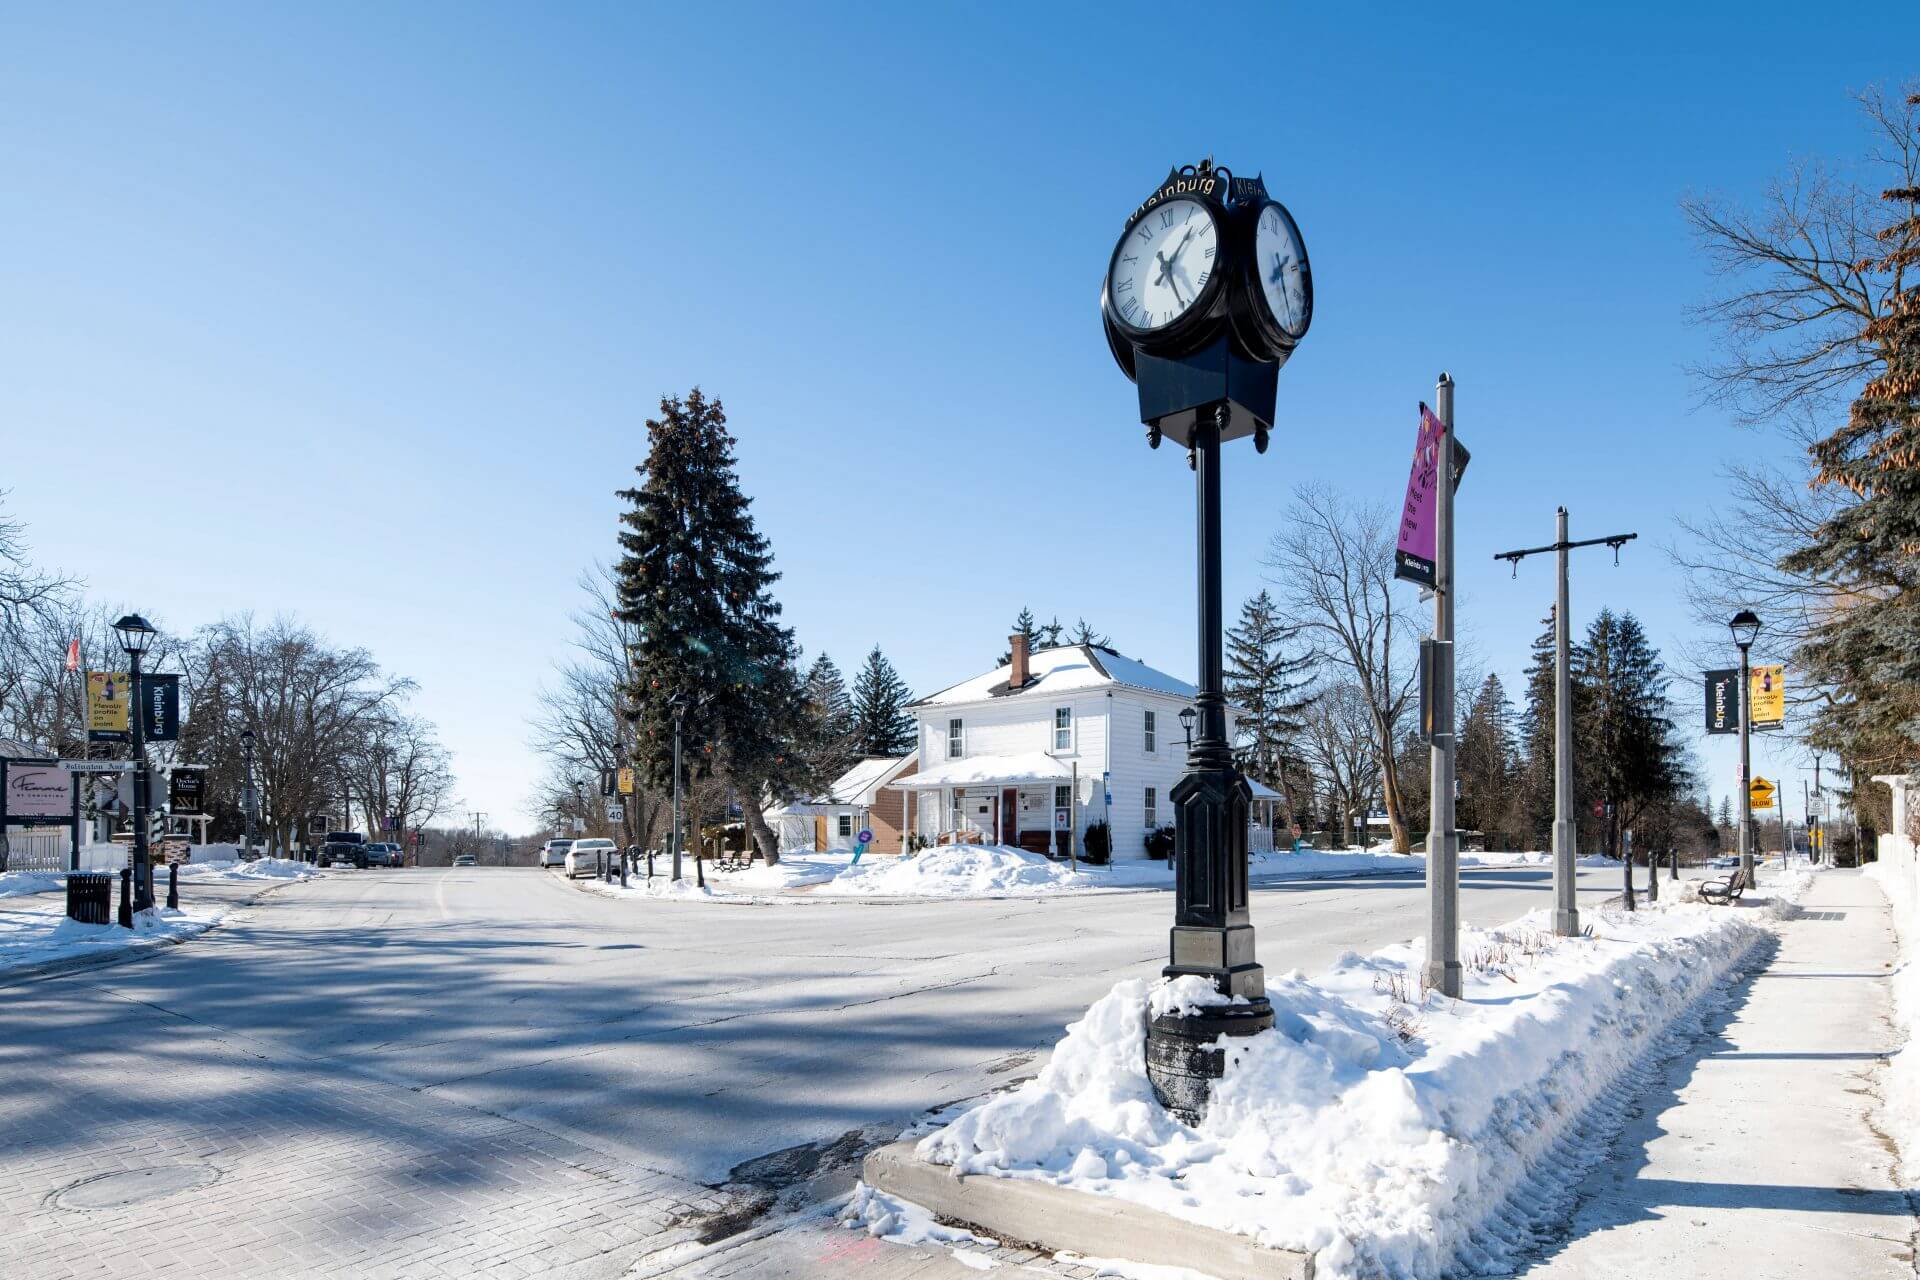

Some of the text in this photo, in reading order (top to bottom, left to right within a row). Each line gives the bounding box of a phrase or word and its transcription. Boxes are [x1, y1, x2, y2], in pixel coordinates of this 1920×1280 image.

[1160, 208, 1174, 231] XII
[1751, 799, 1770, 807] SLOW
[609, 811, 623, 820] 40
